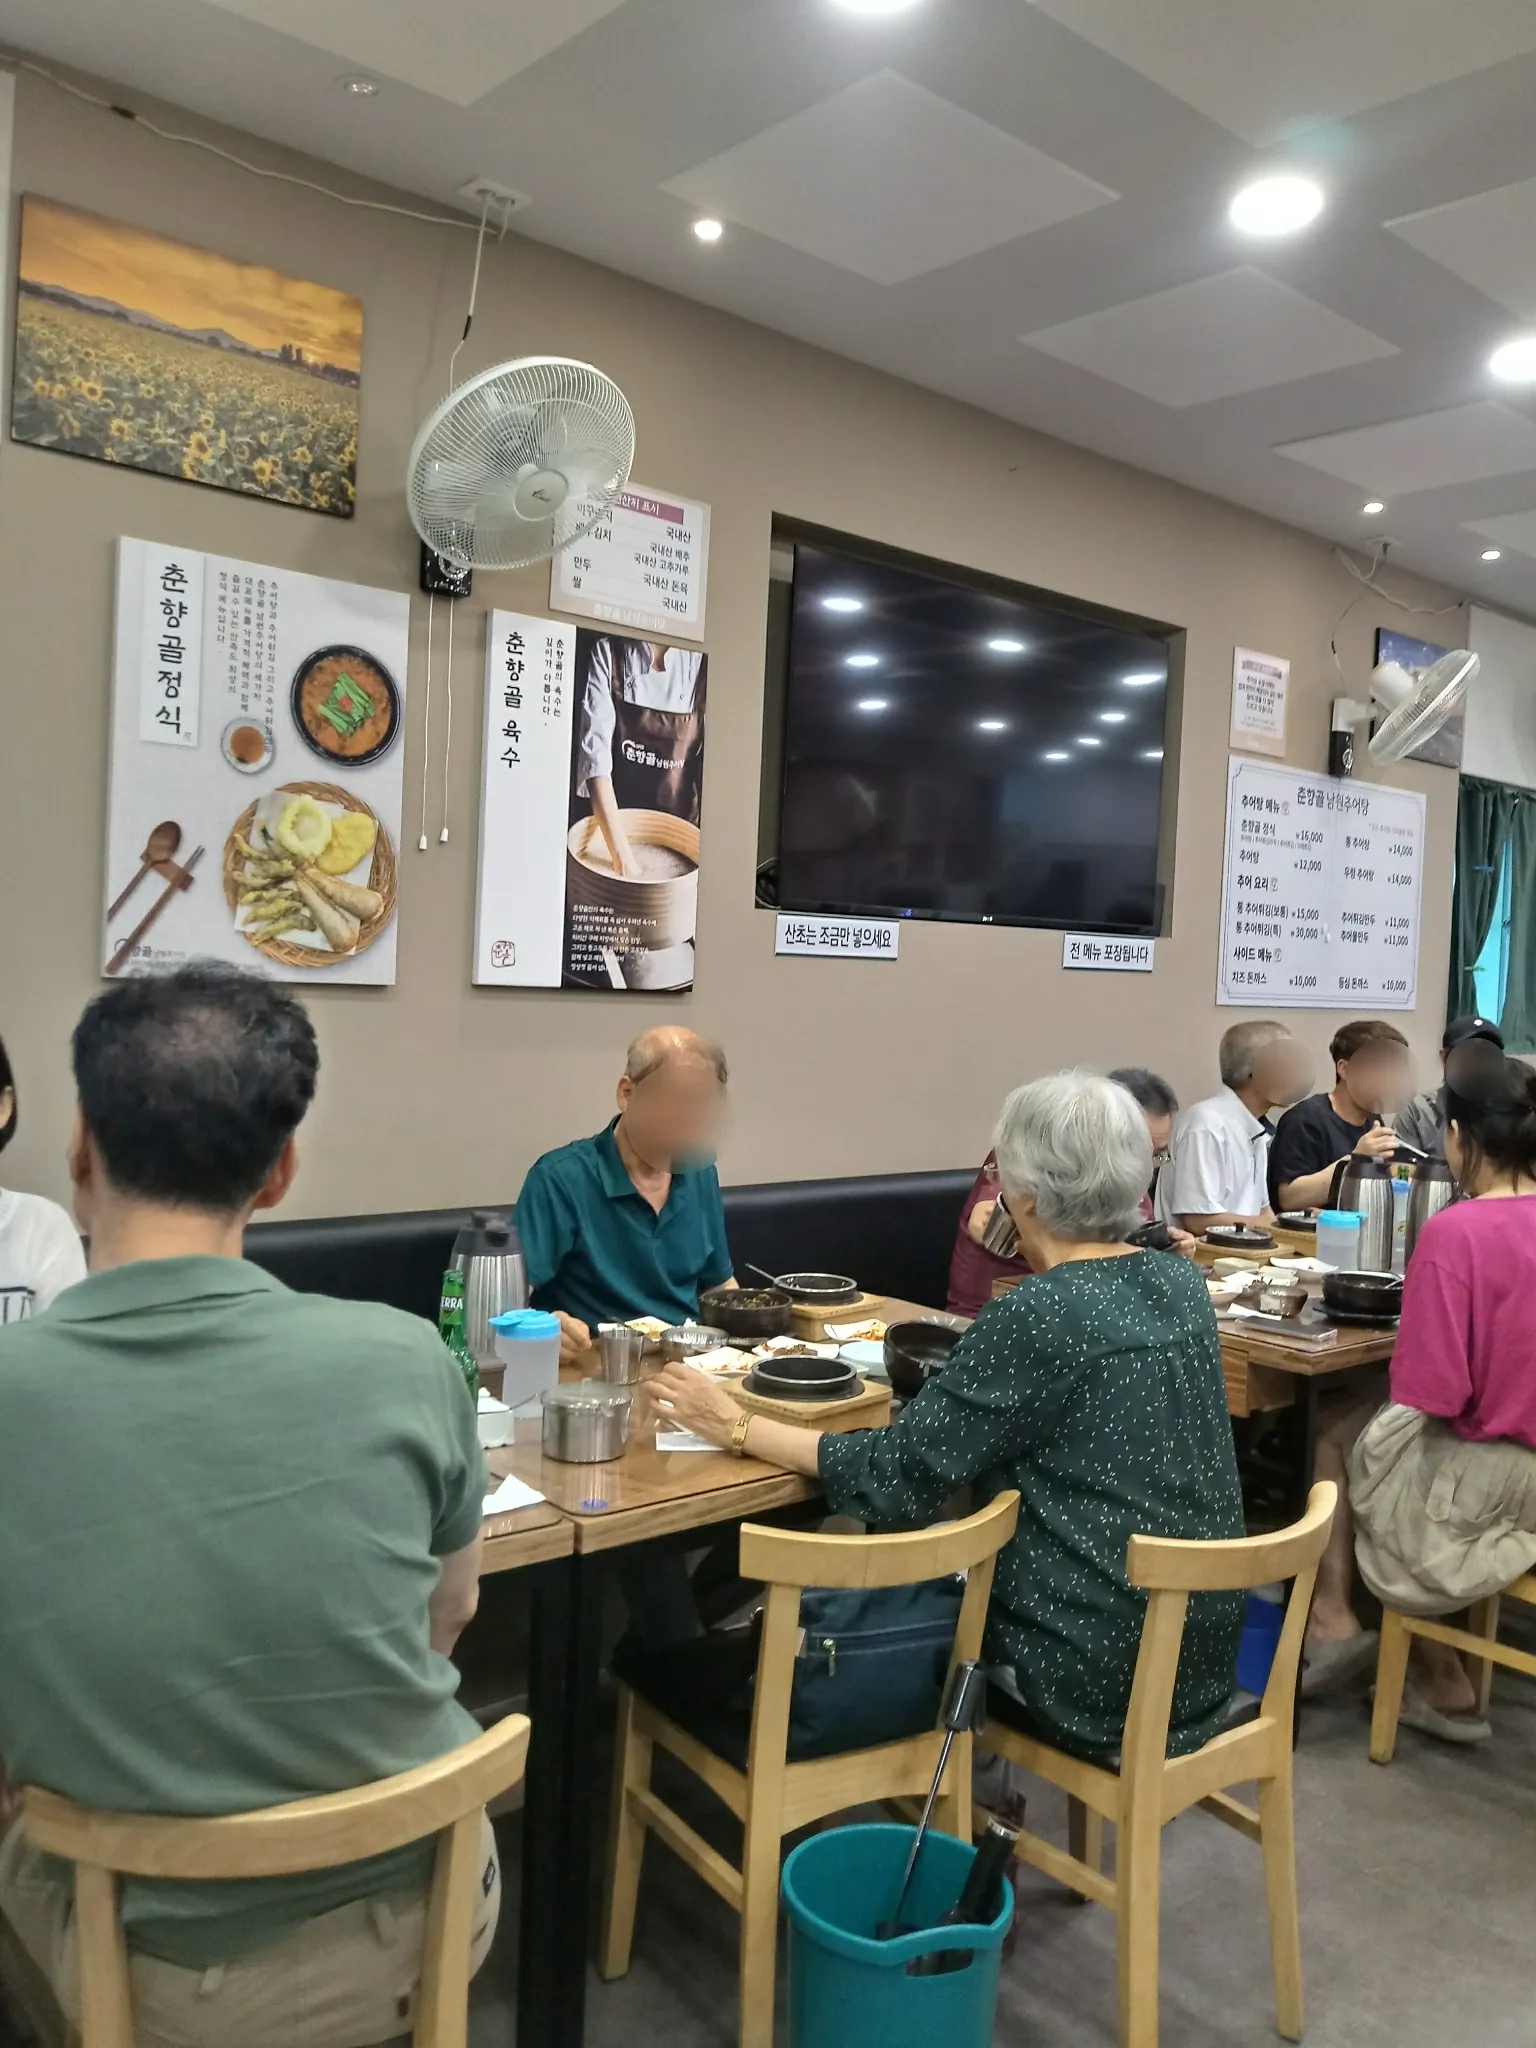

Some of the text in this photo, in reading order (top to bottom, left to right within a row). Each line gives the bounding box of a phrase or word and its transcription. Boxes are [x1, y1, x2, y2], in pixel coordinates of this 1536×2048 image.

[618, 494, 660, 515] 산지 표시
[666, 527, 691, 544] 국내산
[650, 542, 690, 562] 국내산 배추
[574, 556, 592, 571] 만두
[634, 553, 689, 576] 국내산 고추가루
[572, 576, 582, 589] 쌀
[643, 574, 689, 595] 국내산 돈육
[662, 597, 687, 613] 국내산
[545, 638, 553, 669] 깊이가
[553, 639, 564, 717] 춘향골의 육수는
[501, 632, 525, 768] 춘향골 육수
[626, 747, 656, 766] 춘향골
[1242, 794, 1280, 814] 추어탕 메뉴
[1297, 786, 1370, 816] 춘향골 남원추어탕
[1241, 819, 1275, 837] 춘향골 정식
[1353, 837, 1370, 851] 추어탕
[1240, 849, 1259, 864] 추어탕
[1237, 874, 1268, 891] 추어 요리
[1357, 868, 1374, 881] 추어탕
[785, 924, 891, 949] 산초는 조금만 넣으세요
[1070, 942, 1148, 963] 전 메뉴 포장됩니다
[1233, 946, 1272, 962] 사이드 메뉴
[1232, 970, 1267, 985] 치즈 돈까스
[441, 1296, 463, 1310] ERRA
